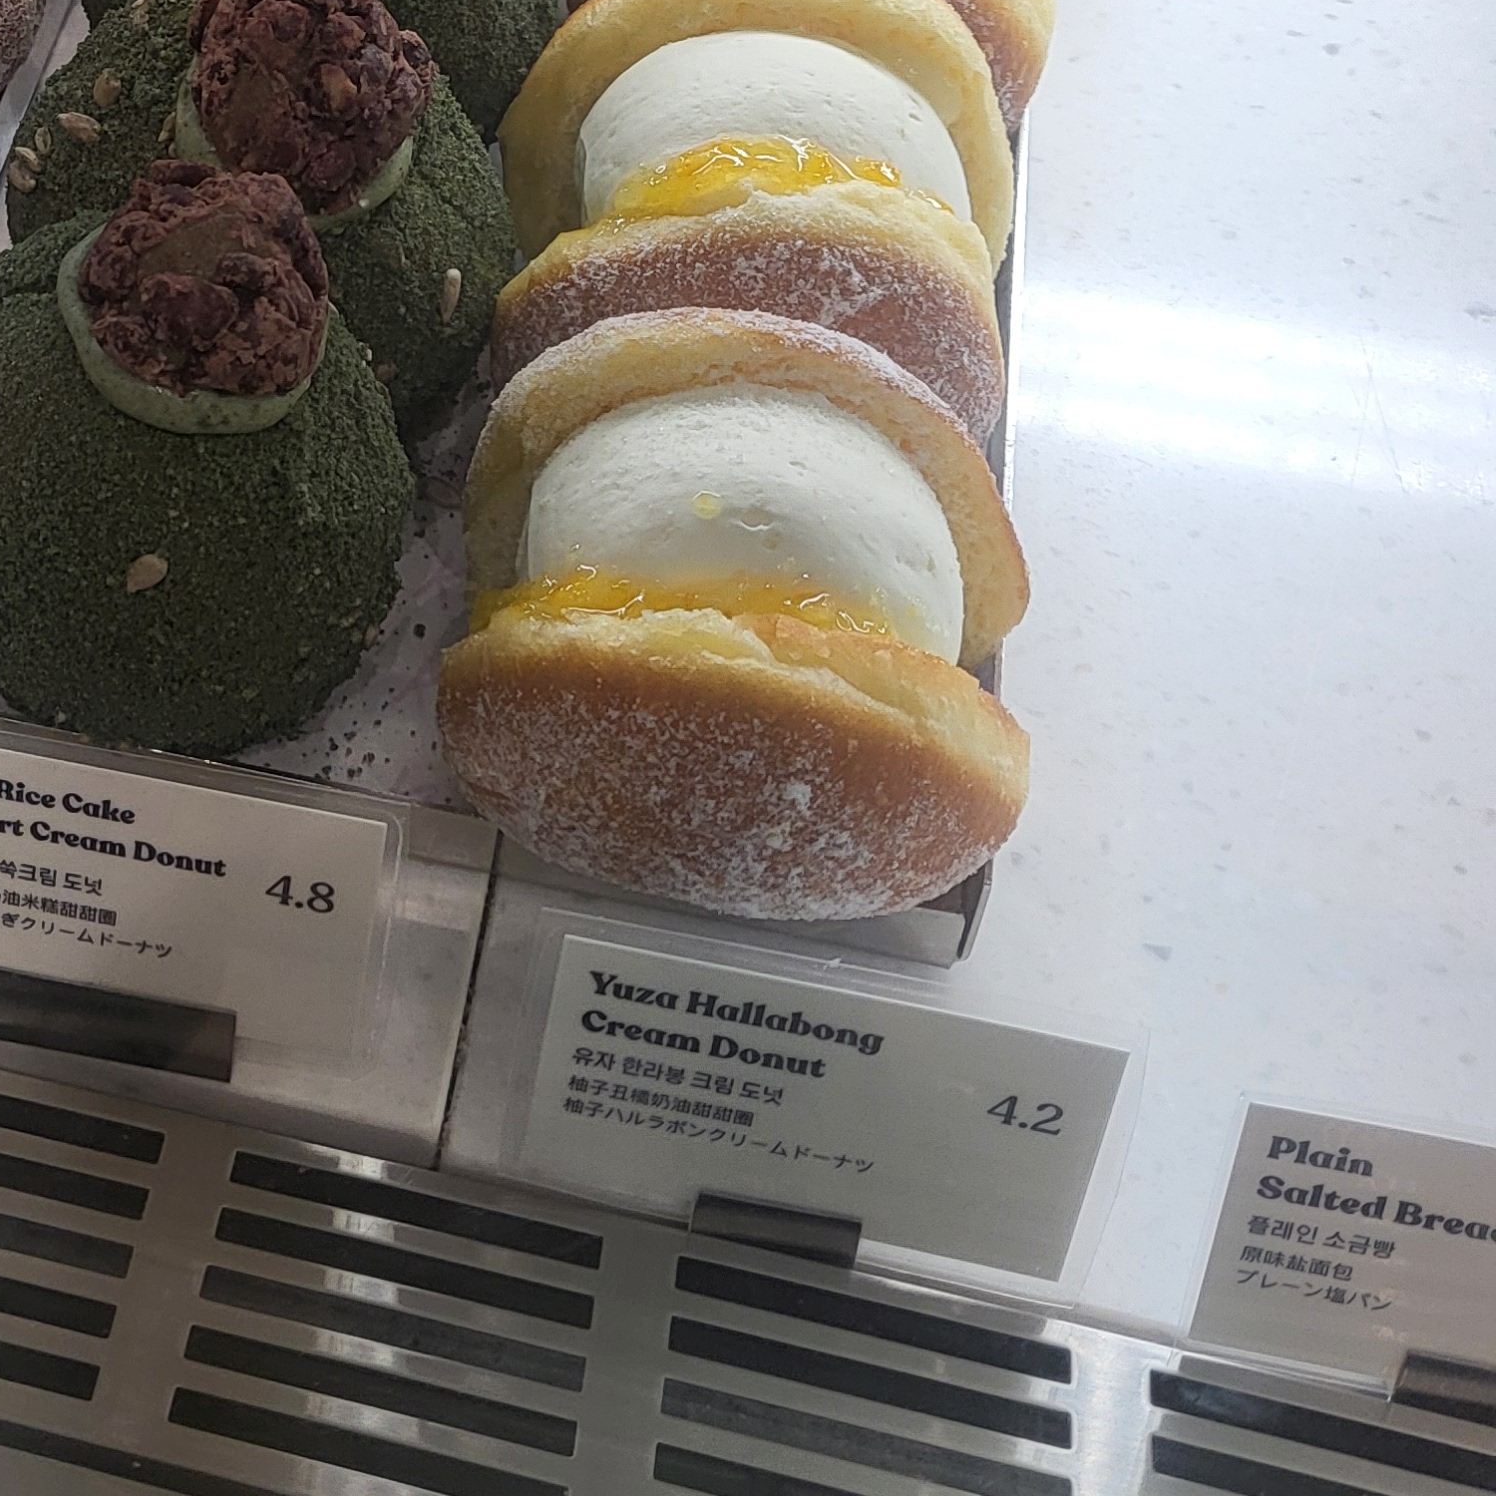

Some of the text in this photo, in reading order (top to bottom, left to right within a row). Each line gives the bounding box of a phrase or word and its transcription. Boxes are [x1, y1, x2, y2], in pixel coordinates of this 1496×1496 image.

[62, 793, 136, 825] Cake
[30, 821, 126, 858] Cream
[133, 839, 227, 877] Donut
[63, 872, 102, 896] 도넛
[265, 875, 336, 914] 4.8
[589, 970, 884, 1056] Yuza Hallabong
[582, 1010, 826, 1079] Cream Donut
[568, 1075, 754, 1127] 柚子丑橘奶油甜甜圈
[572, 1047, 783, 1107] 유자 한라봉 크림 도넛
[987, 1095, 1064, 1136] 4.2
[1266, 1135, 1373, 1177] Plain
[1257, 1175, 1496, 1244] Salted Brea
[1248, 1215, 1395, 1259] 플레인 소금빵
